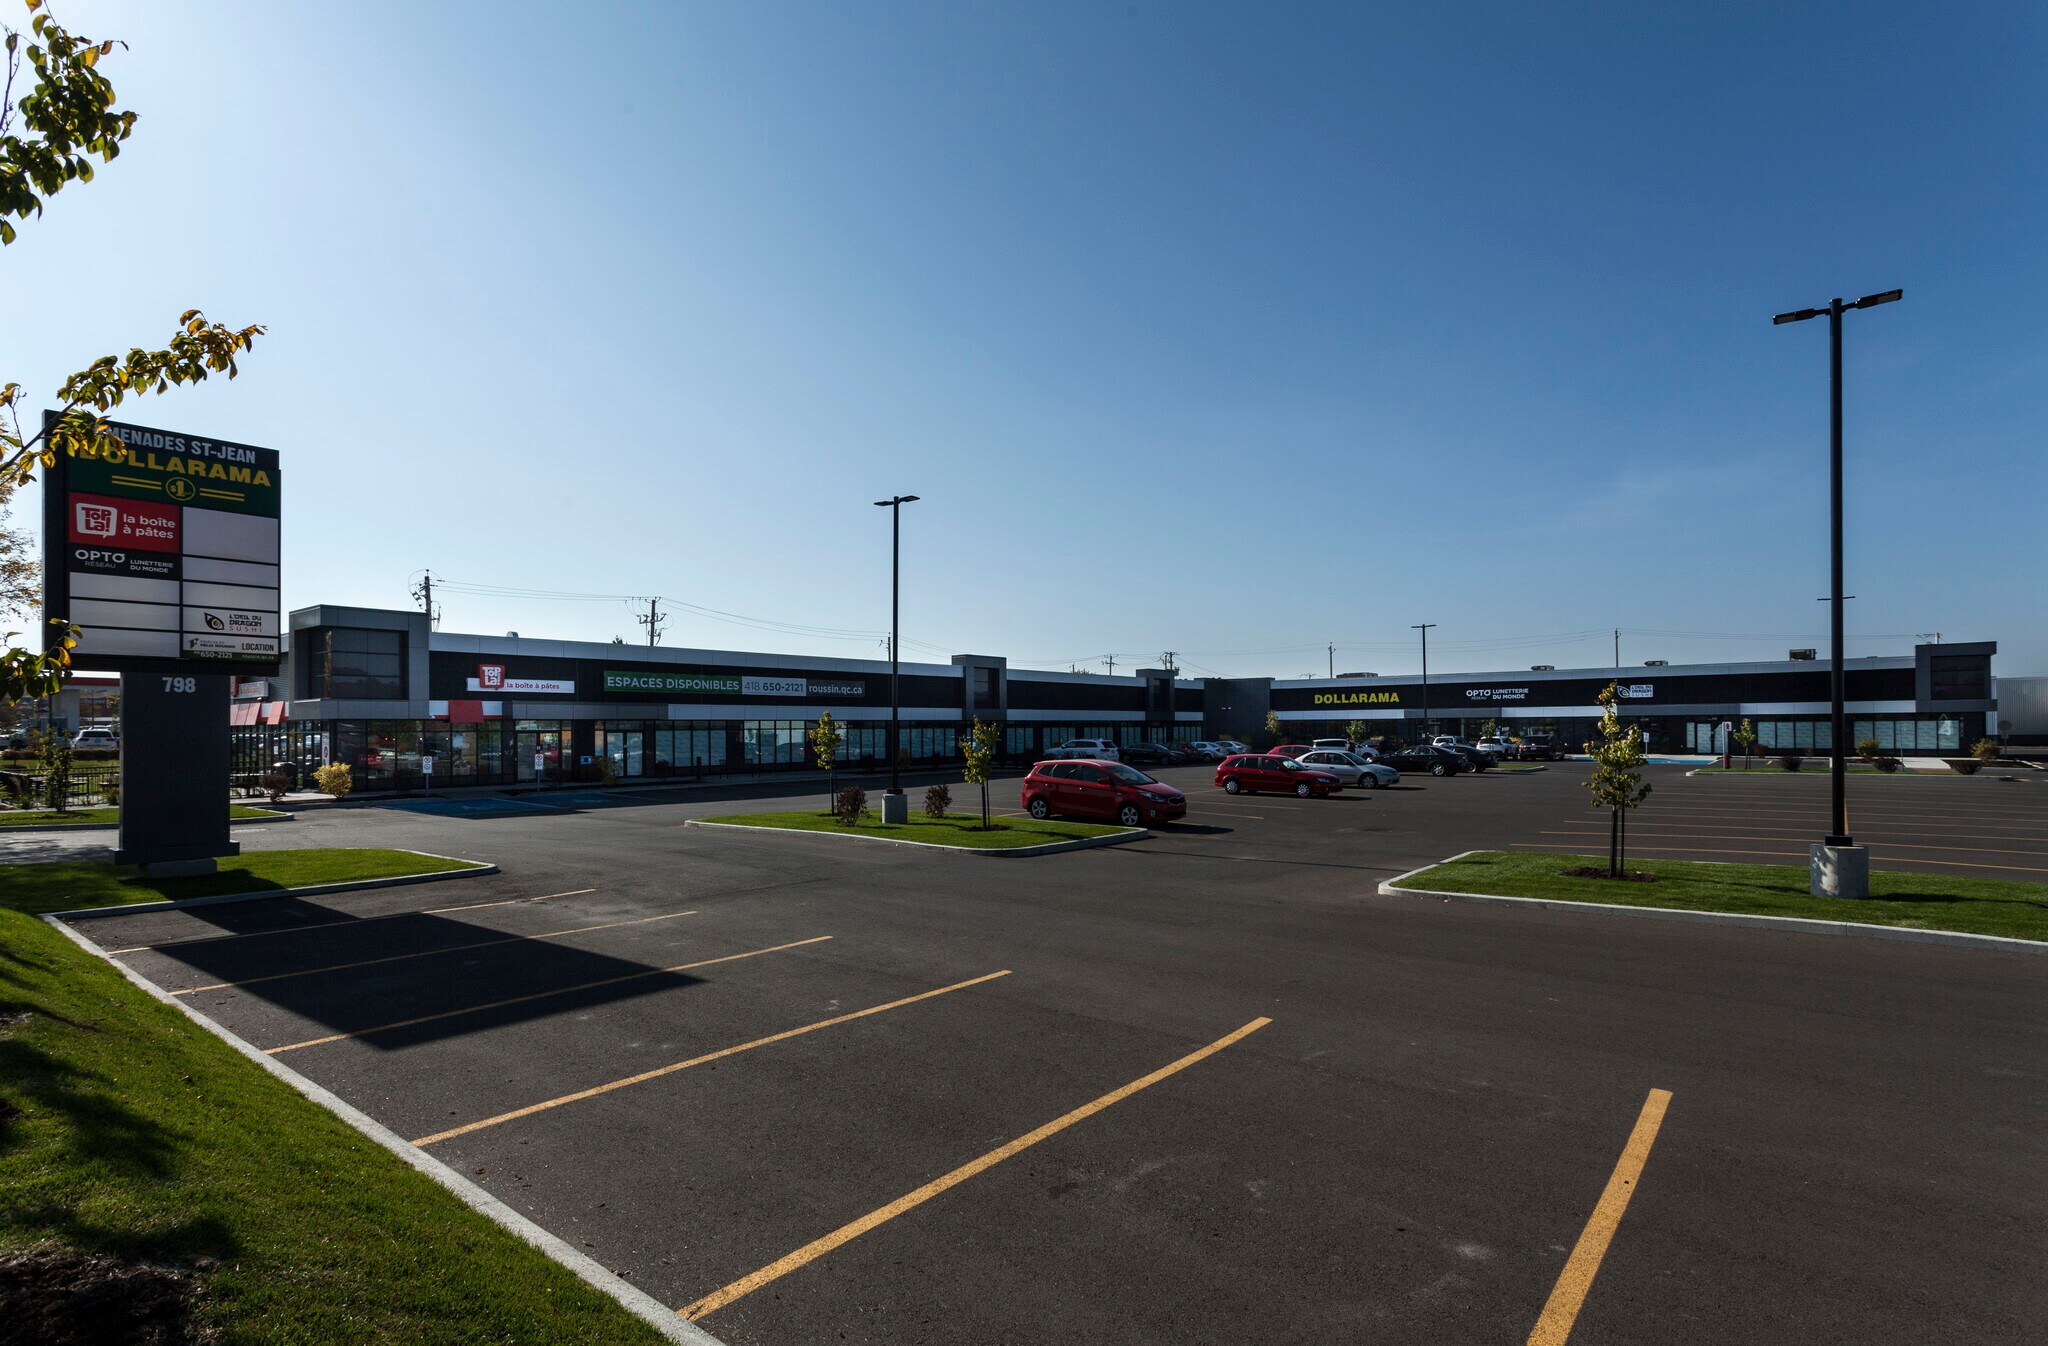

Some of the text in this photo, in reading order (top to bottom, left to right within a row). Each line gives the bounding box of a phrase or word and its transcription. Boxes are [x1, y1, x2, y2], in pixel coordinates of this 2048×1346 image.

[109, 427, 256, 464] MENADES ST-JEAN
[123, 513, 176, 528] la boîte
[123, 524, 174, 539] à pâtes
[75, 549, 126, 563] OPTO
[130, 559, 174, 569] LUNETTERIE
[142, 565, 169, 574] MONDE
[241, 643, 275, 652] LOCATION
[200, 651, 233, 659] 650-2121
[162, 676, 196, 693] 798
[541, 682, 560, 690] pâtes
[607, 676, 740, 690] ESPACES DISPONIBLES
[744, 681, 804, 692] 418 650-2121
[809, 684, 862, 695] roussin.qc.ca
[1466, 689, 1491, 697] OPTO
[1314, 692, 1400, 704] DOLLARAMA
